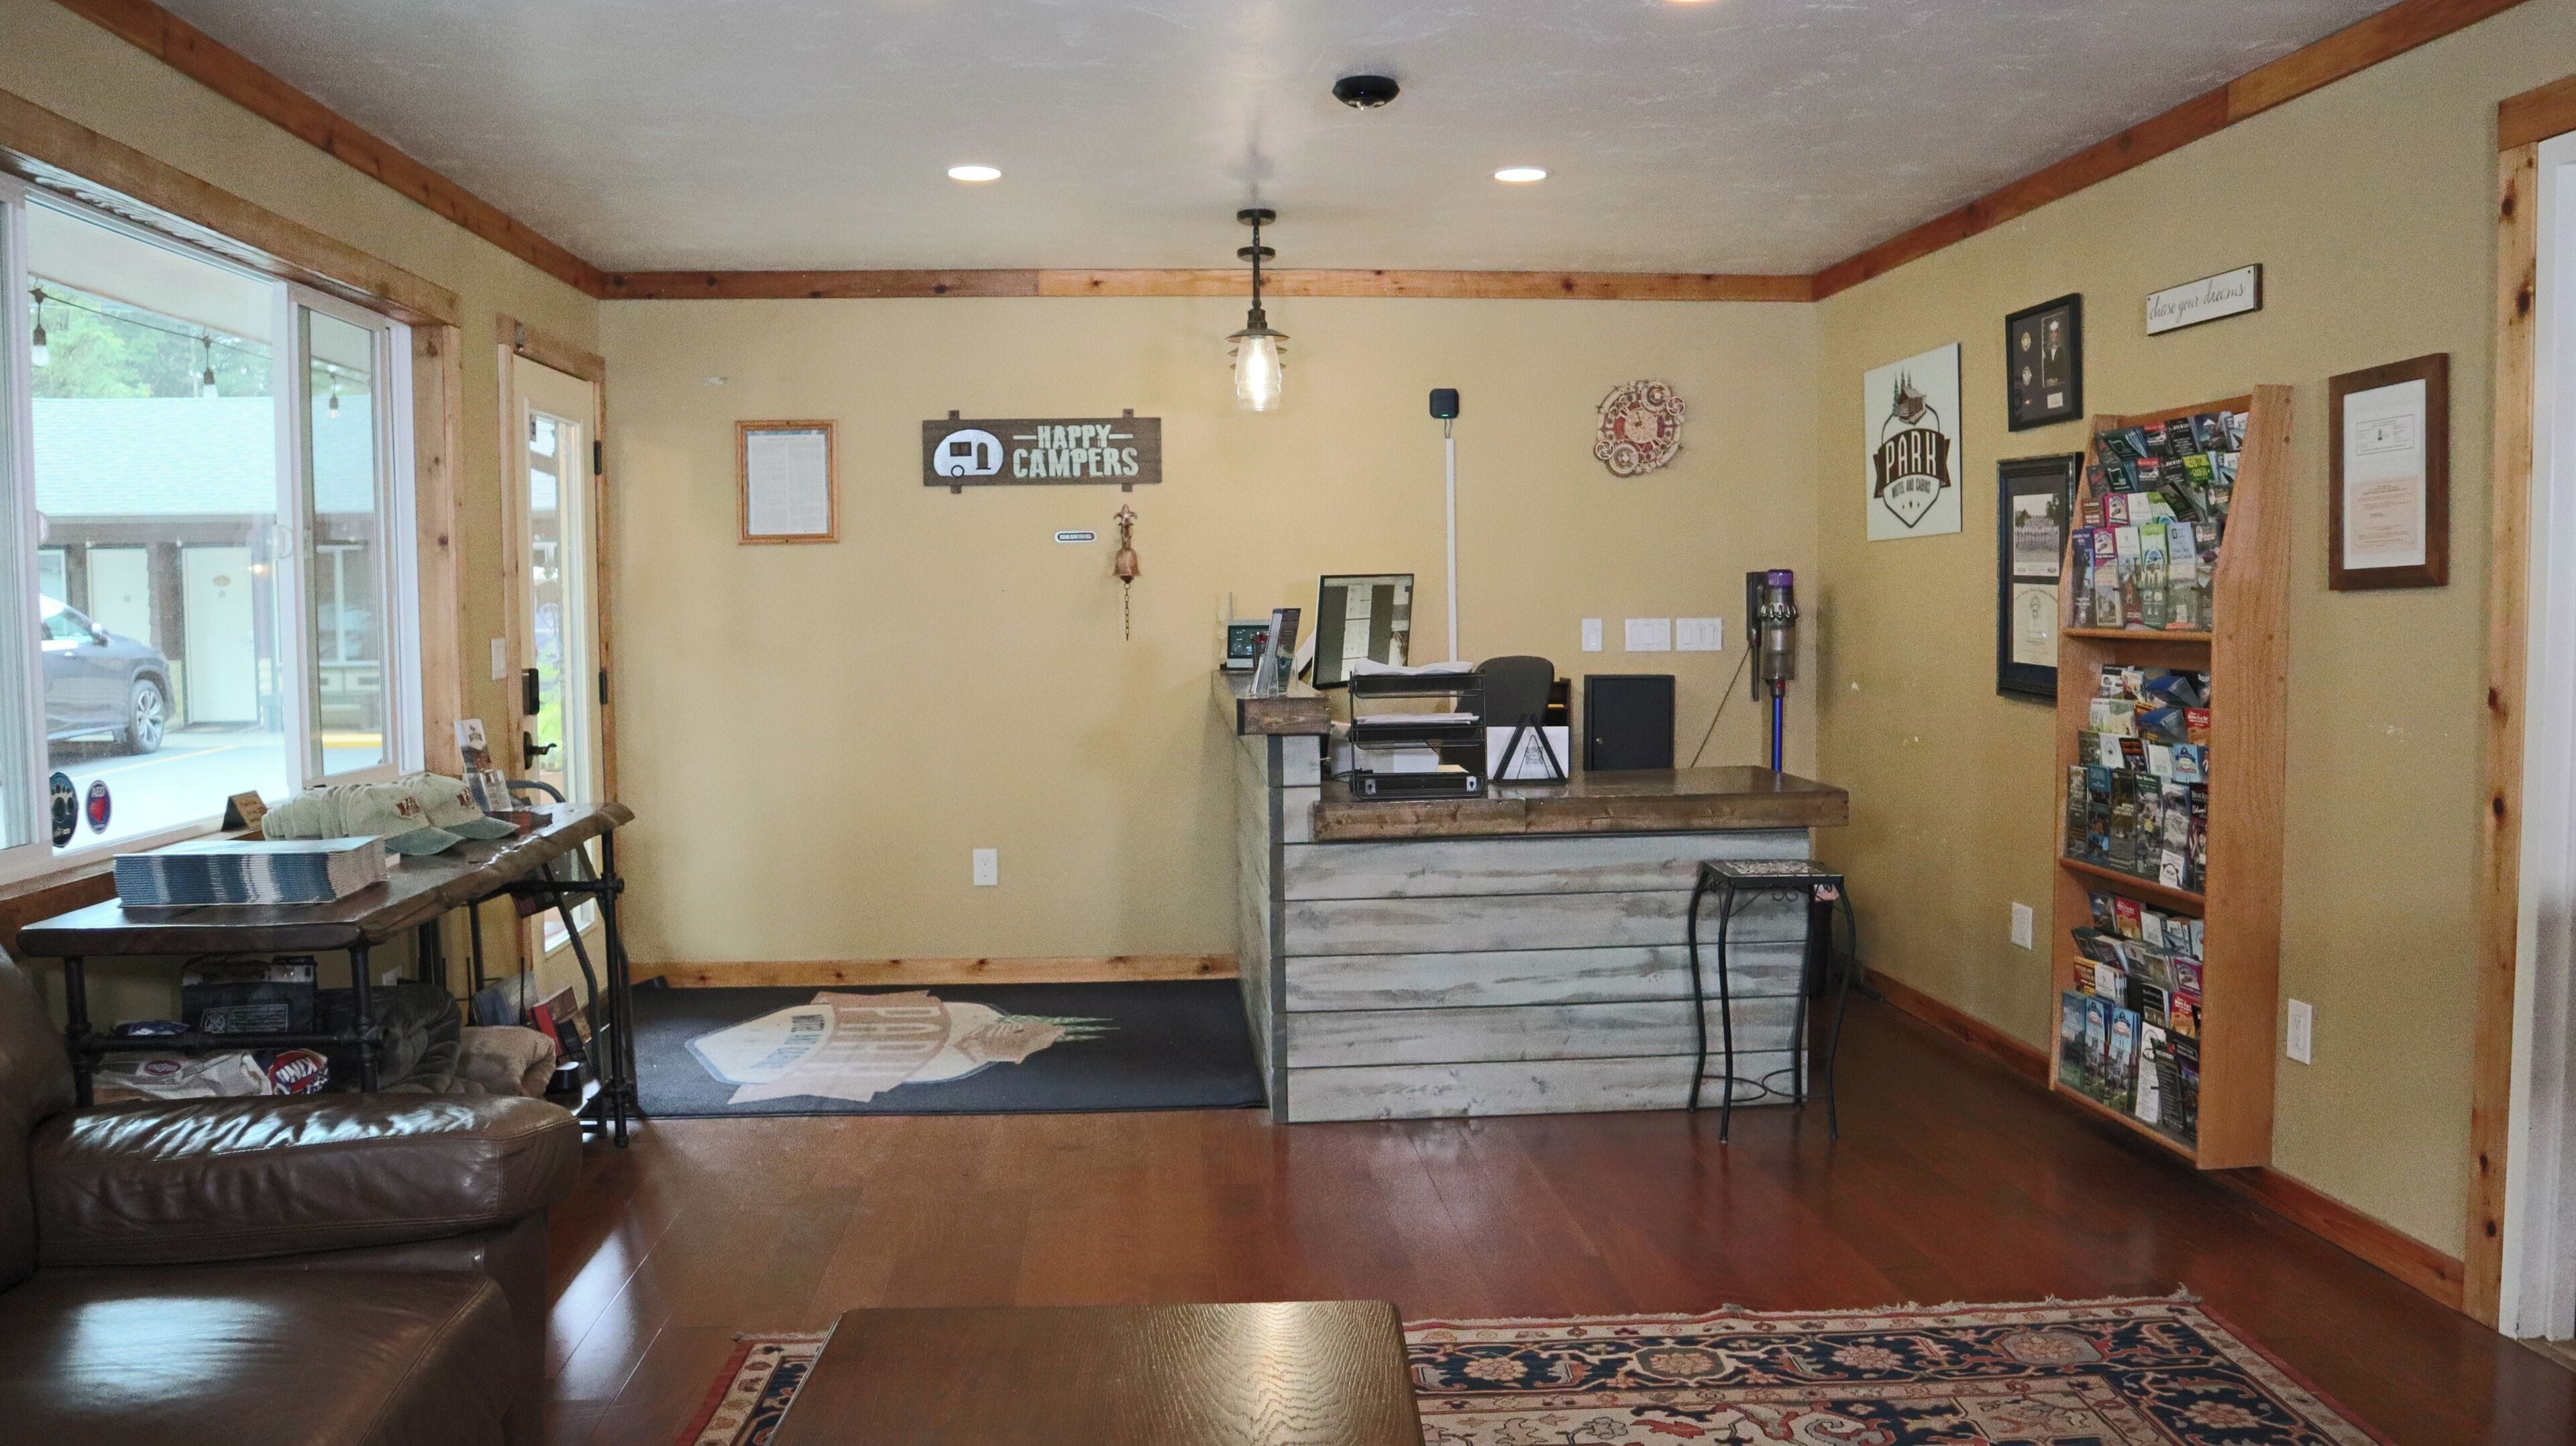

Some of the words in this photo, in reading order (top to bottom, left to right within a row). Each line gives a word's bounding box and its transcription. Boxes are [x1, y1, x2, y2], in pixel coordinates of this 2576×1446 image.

[2149, 295, 2175, 320] chase
[2178, 297, 2199, 323] your
[2203, 278, 2245, 305] dreams
[1037, 424, 1112, 450] HAPPY
[1013, 447, 1139, 478] CAMPERS
[1886, 430, 1937, 484] PARK
